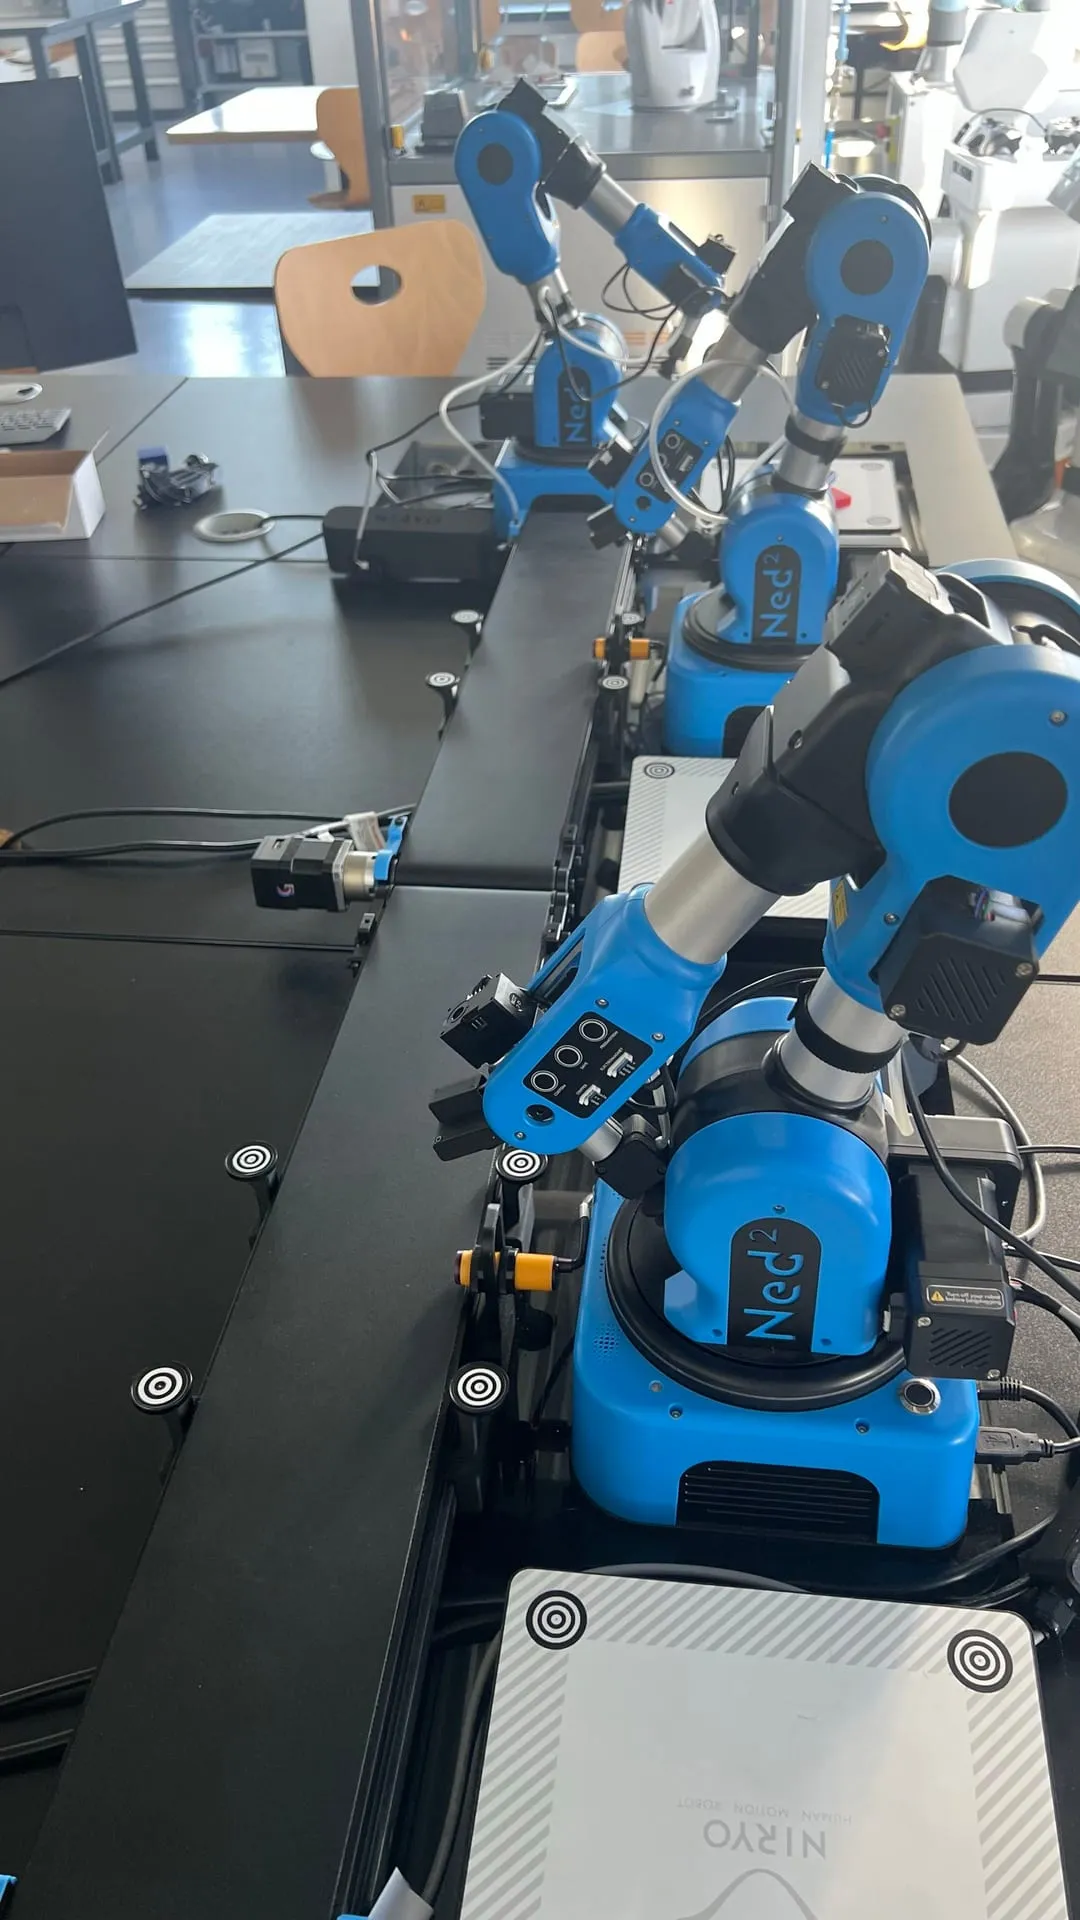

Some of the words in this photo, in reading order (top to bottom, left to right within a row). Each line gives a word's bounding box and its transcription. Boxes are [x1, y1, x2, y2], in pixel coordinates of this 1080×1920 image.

[733, 1803, 789, 1818] MOTION
[801, 1810, 852, 1826] HUMAN
[703, 1819, 826, 1860] NIRYO
